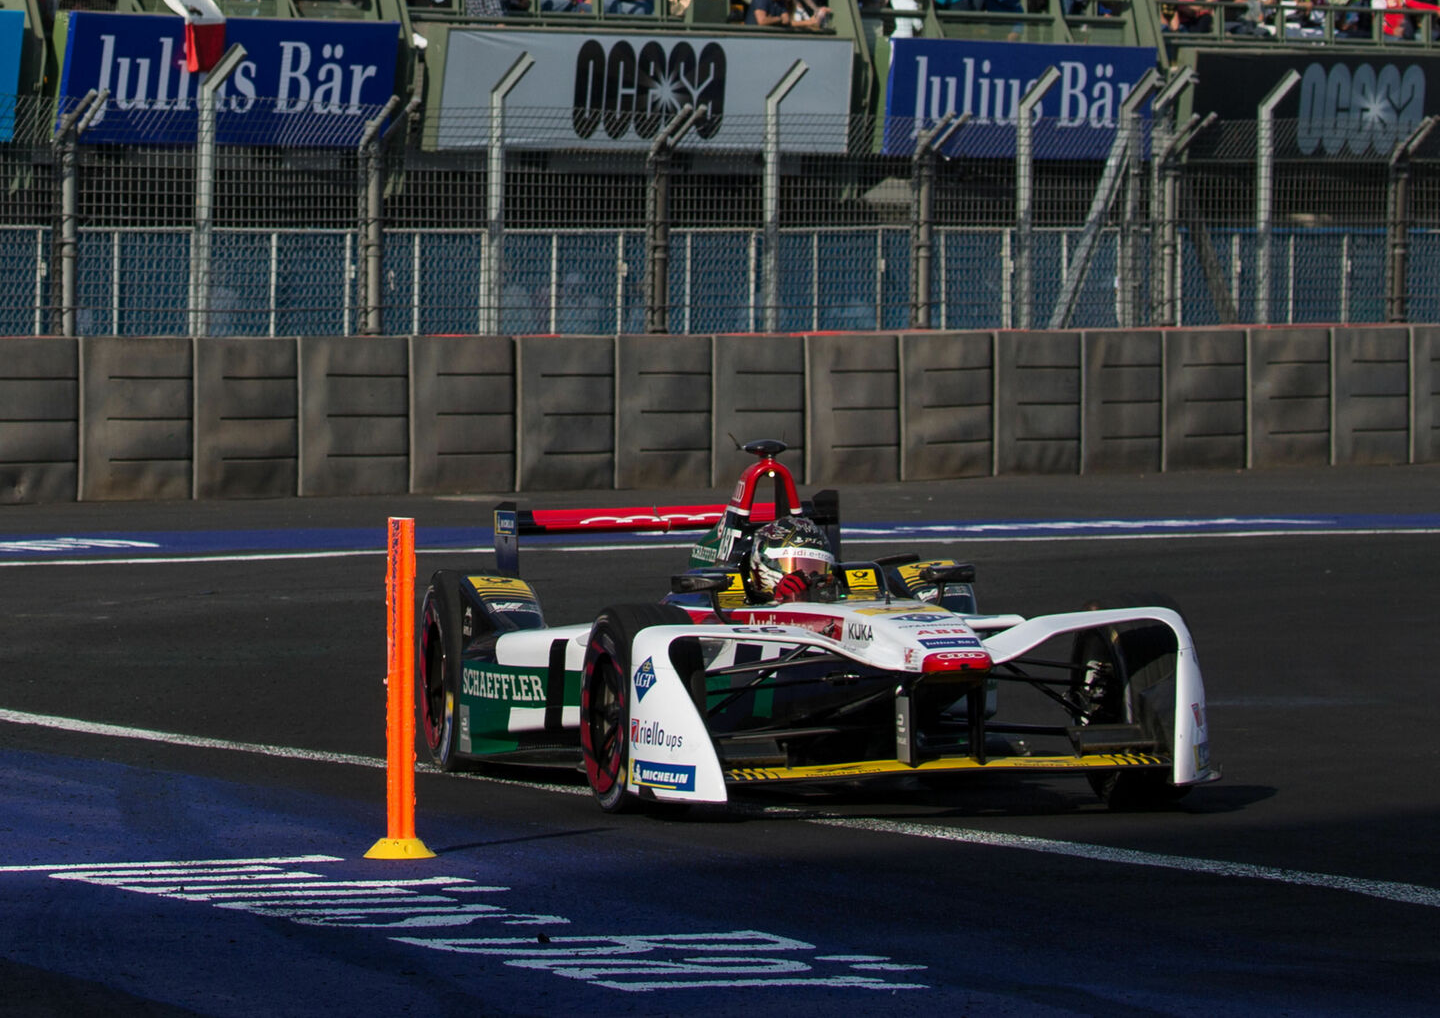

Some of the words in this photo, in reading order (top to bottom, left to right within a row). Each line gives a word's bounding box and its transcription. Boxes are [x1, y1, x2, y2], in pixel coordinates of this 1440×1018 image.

[273, 41, 378, 117] Bär
[848, 623, 873, 641] KUKA
[463, 667, 547, 701] SCHAEFFLER
[636, 672, 654, 688] LGT
[640, 720, 665, 747] riello
[666, 734, 683, 751] ups
[642, 769, 689, 784] MICHELIN
